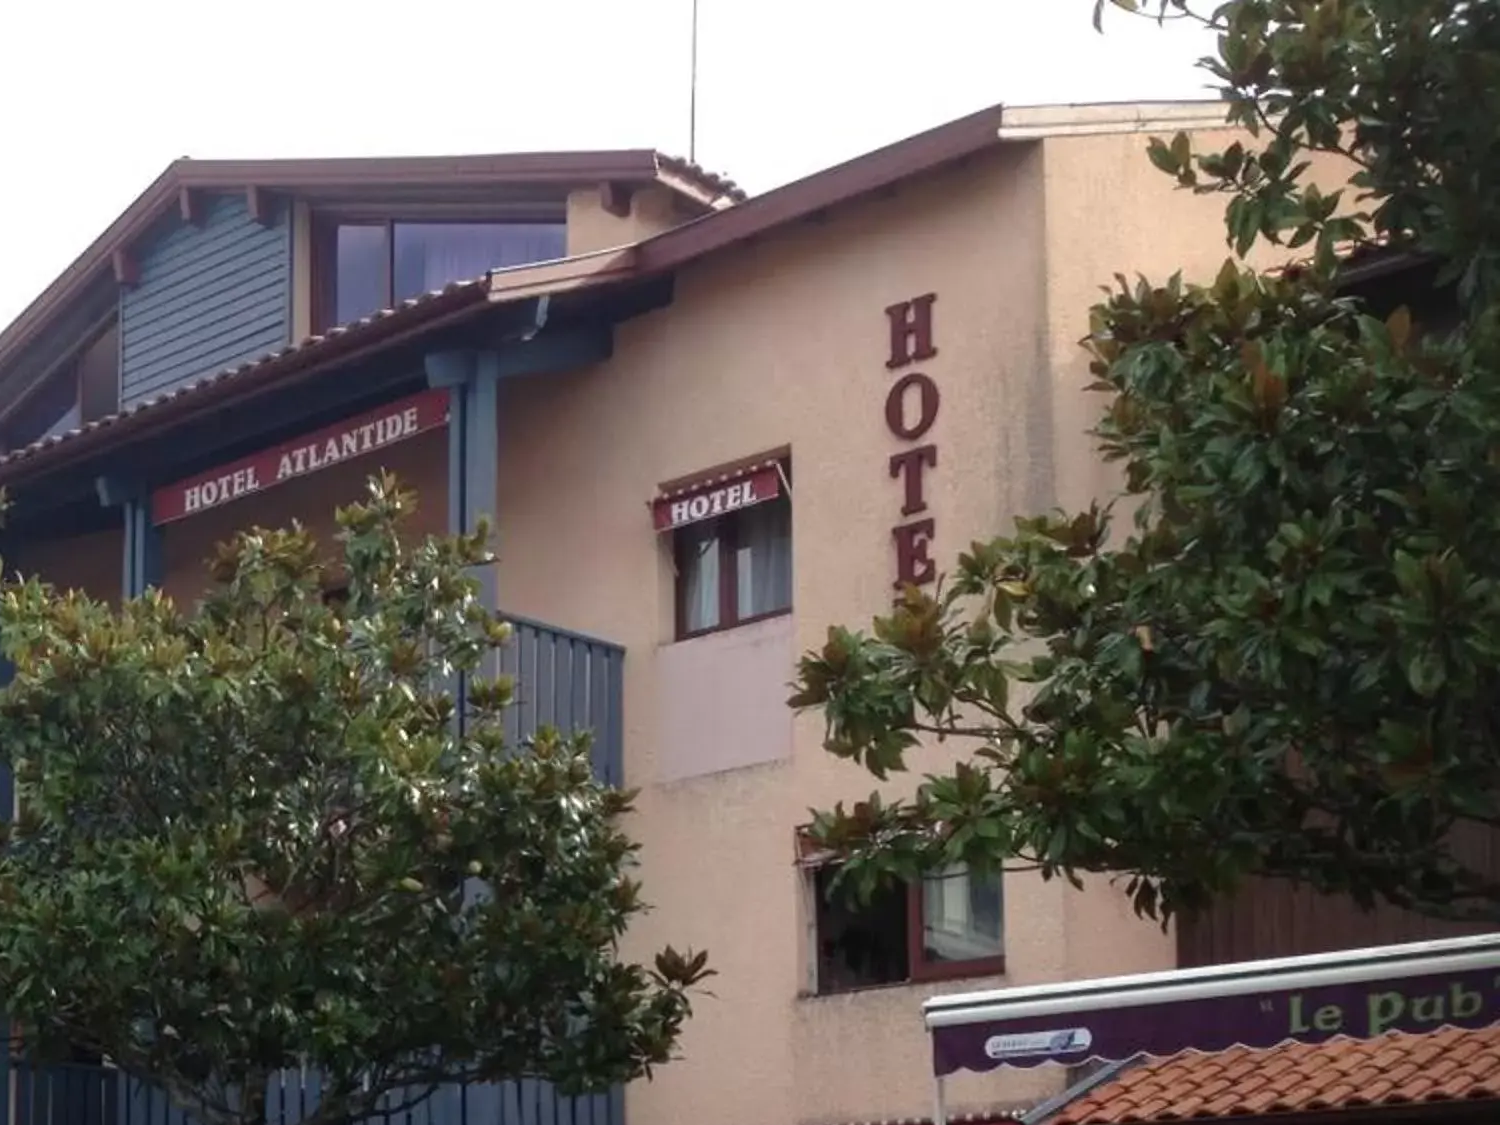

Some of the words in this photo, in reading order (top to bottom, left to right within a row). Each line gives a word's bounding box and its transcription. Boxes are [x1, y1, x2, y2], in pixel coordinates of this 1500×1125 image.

[184, 466, 260, 512] HOTEL
[276, 407, 418, 479] ATLANTIDE
[886, 292, 939, 607] HOTE
[671, 480, 757, 527] HOTEL
